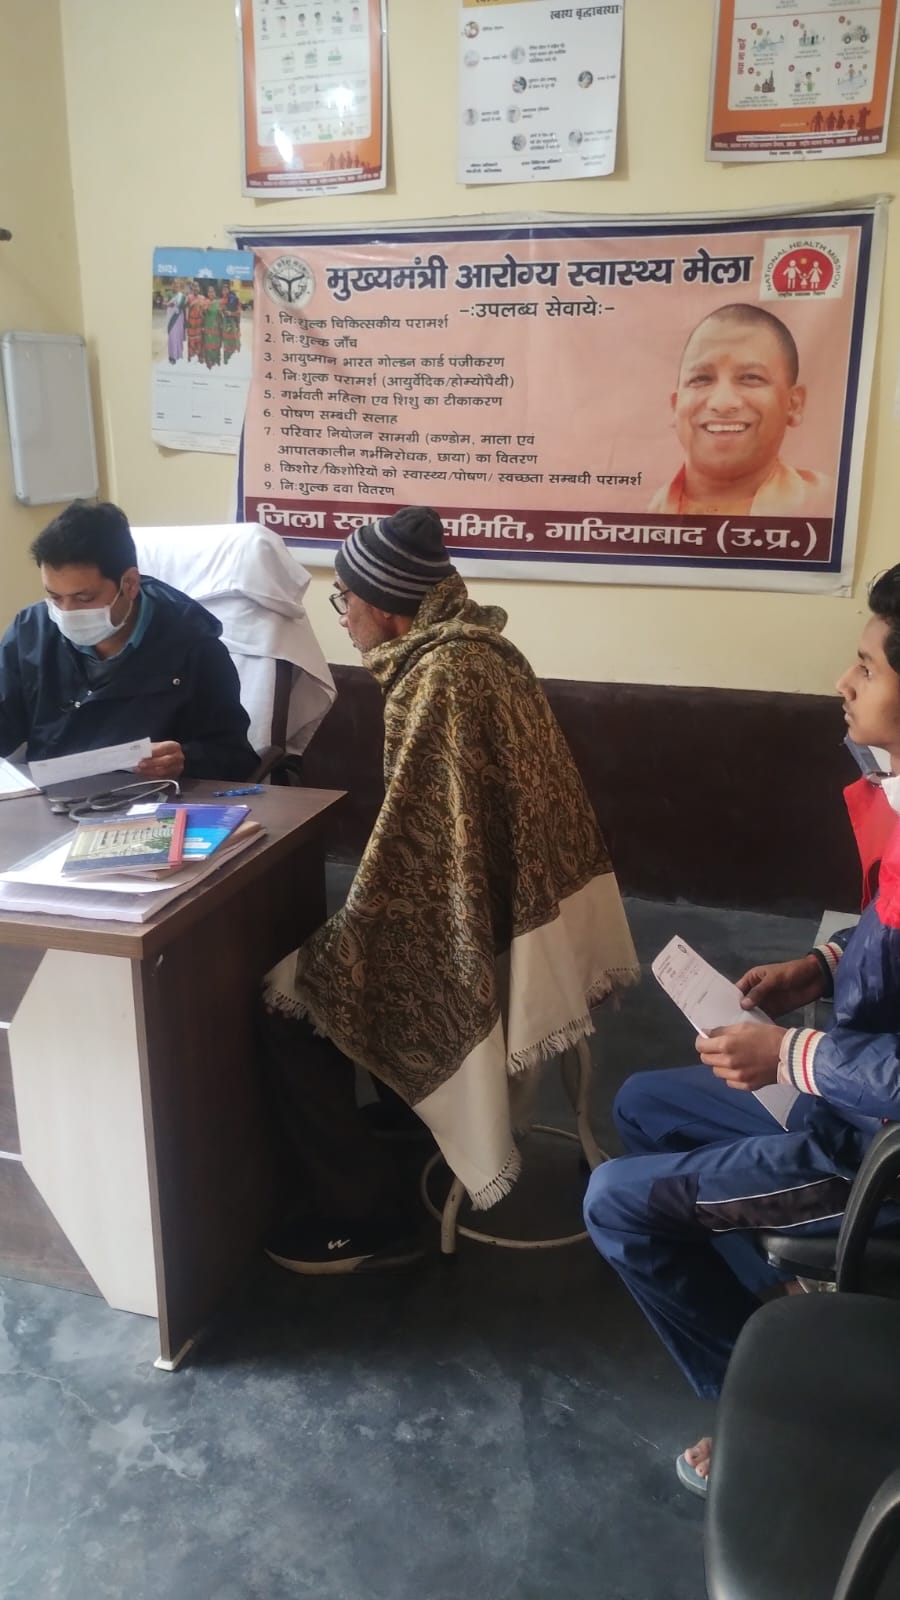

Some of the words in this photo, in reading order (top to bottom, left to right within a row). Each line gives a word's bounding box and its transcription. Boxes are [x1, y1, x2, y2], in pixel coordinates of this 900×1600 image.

[326, 255, 448, 300] मुख्यमंत्री
[455, 254, 560, 289] आरोग्य
[567, 258, 674, 286] स्वास्थ्य
[683, 248, 753, 285] मेला
[765, 249, 787, 291] NATIONAL
[789, 241, 828, 252] HEALTH
[827, 249, 842, 289] MISSION
[331, 316, 400, 329] चिकित्सकीय
[405, 314, 448, 328] परामर्श
[264, 333, 276, 343] 2.
[282, 353, 336, 367] आयुष्मान
[343, 358, 373, 367] भारत
[378, 354, 416, 368] गोल्डन
[420, 353, 445, 367] कार्ड
[334, 373, 377, 386] परामर्श
[280, 387, 323, 400] गर्भवती
[327, 390, 366, 404] महिला
[393, 392, 419, 409] शिशु
[424, 397, 439, 406] का
[444, 393, 502, 406] टीकाकरण
[280, 405, 314, 419] पोषण
[362, 413, 398, 425] सलाह
[280, 424, 322, 438] परिवार
[326, 426, 373, 440] नियोजन
[378, 430, 420, 442] सामग्री
[480, 434, 512, 445] माला
[516, 433, 535, 446] एवं
[278, 445, 356, 458] आपातकालीन
[437, 452, 470, 464] छाया)
[475, 453, 491, 463] का
[496, 450, 538, 464] वितरण
[382, 466, 397, 478] को
[498, 473, 544, 483] स्वच्छता
[596, 472, 642, 486] परामर्श
[333, 484, 353, 494] दवा
[358, 482, 395, 496] वितरण
[256, 503, 326, 529] जिला
[545, 518, 706, 545] गाजियाबाद
[717, 520, 817, 556] (उ.प्र.)
